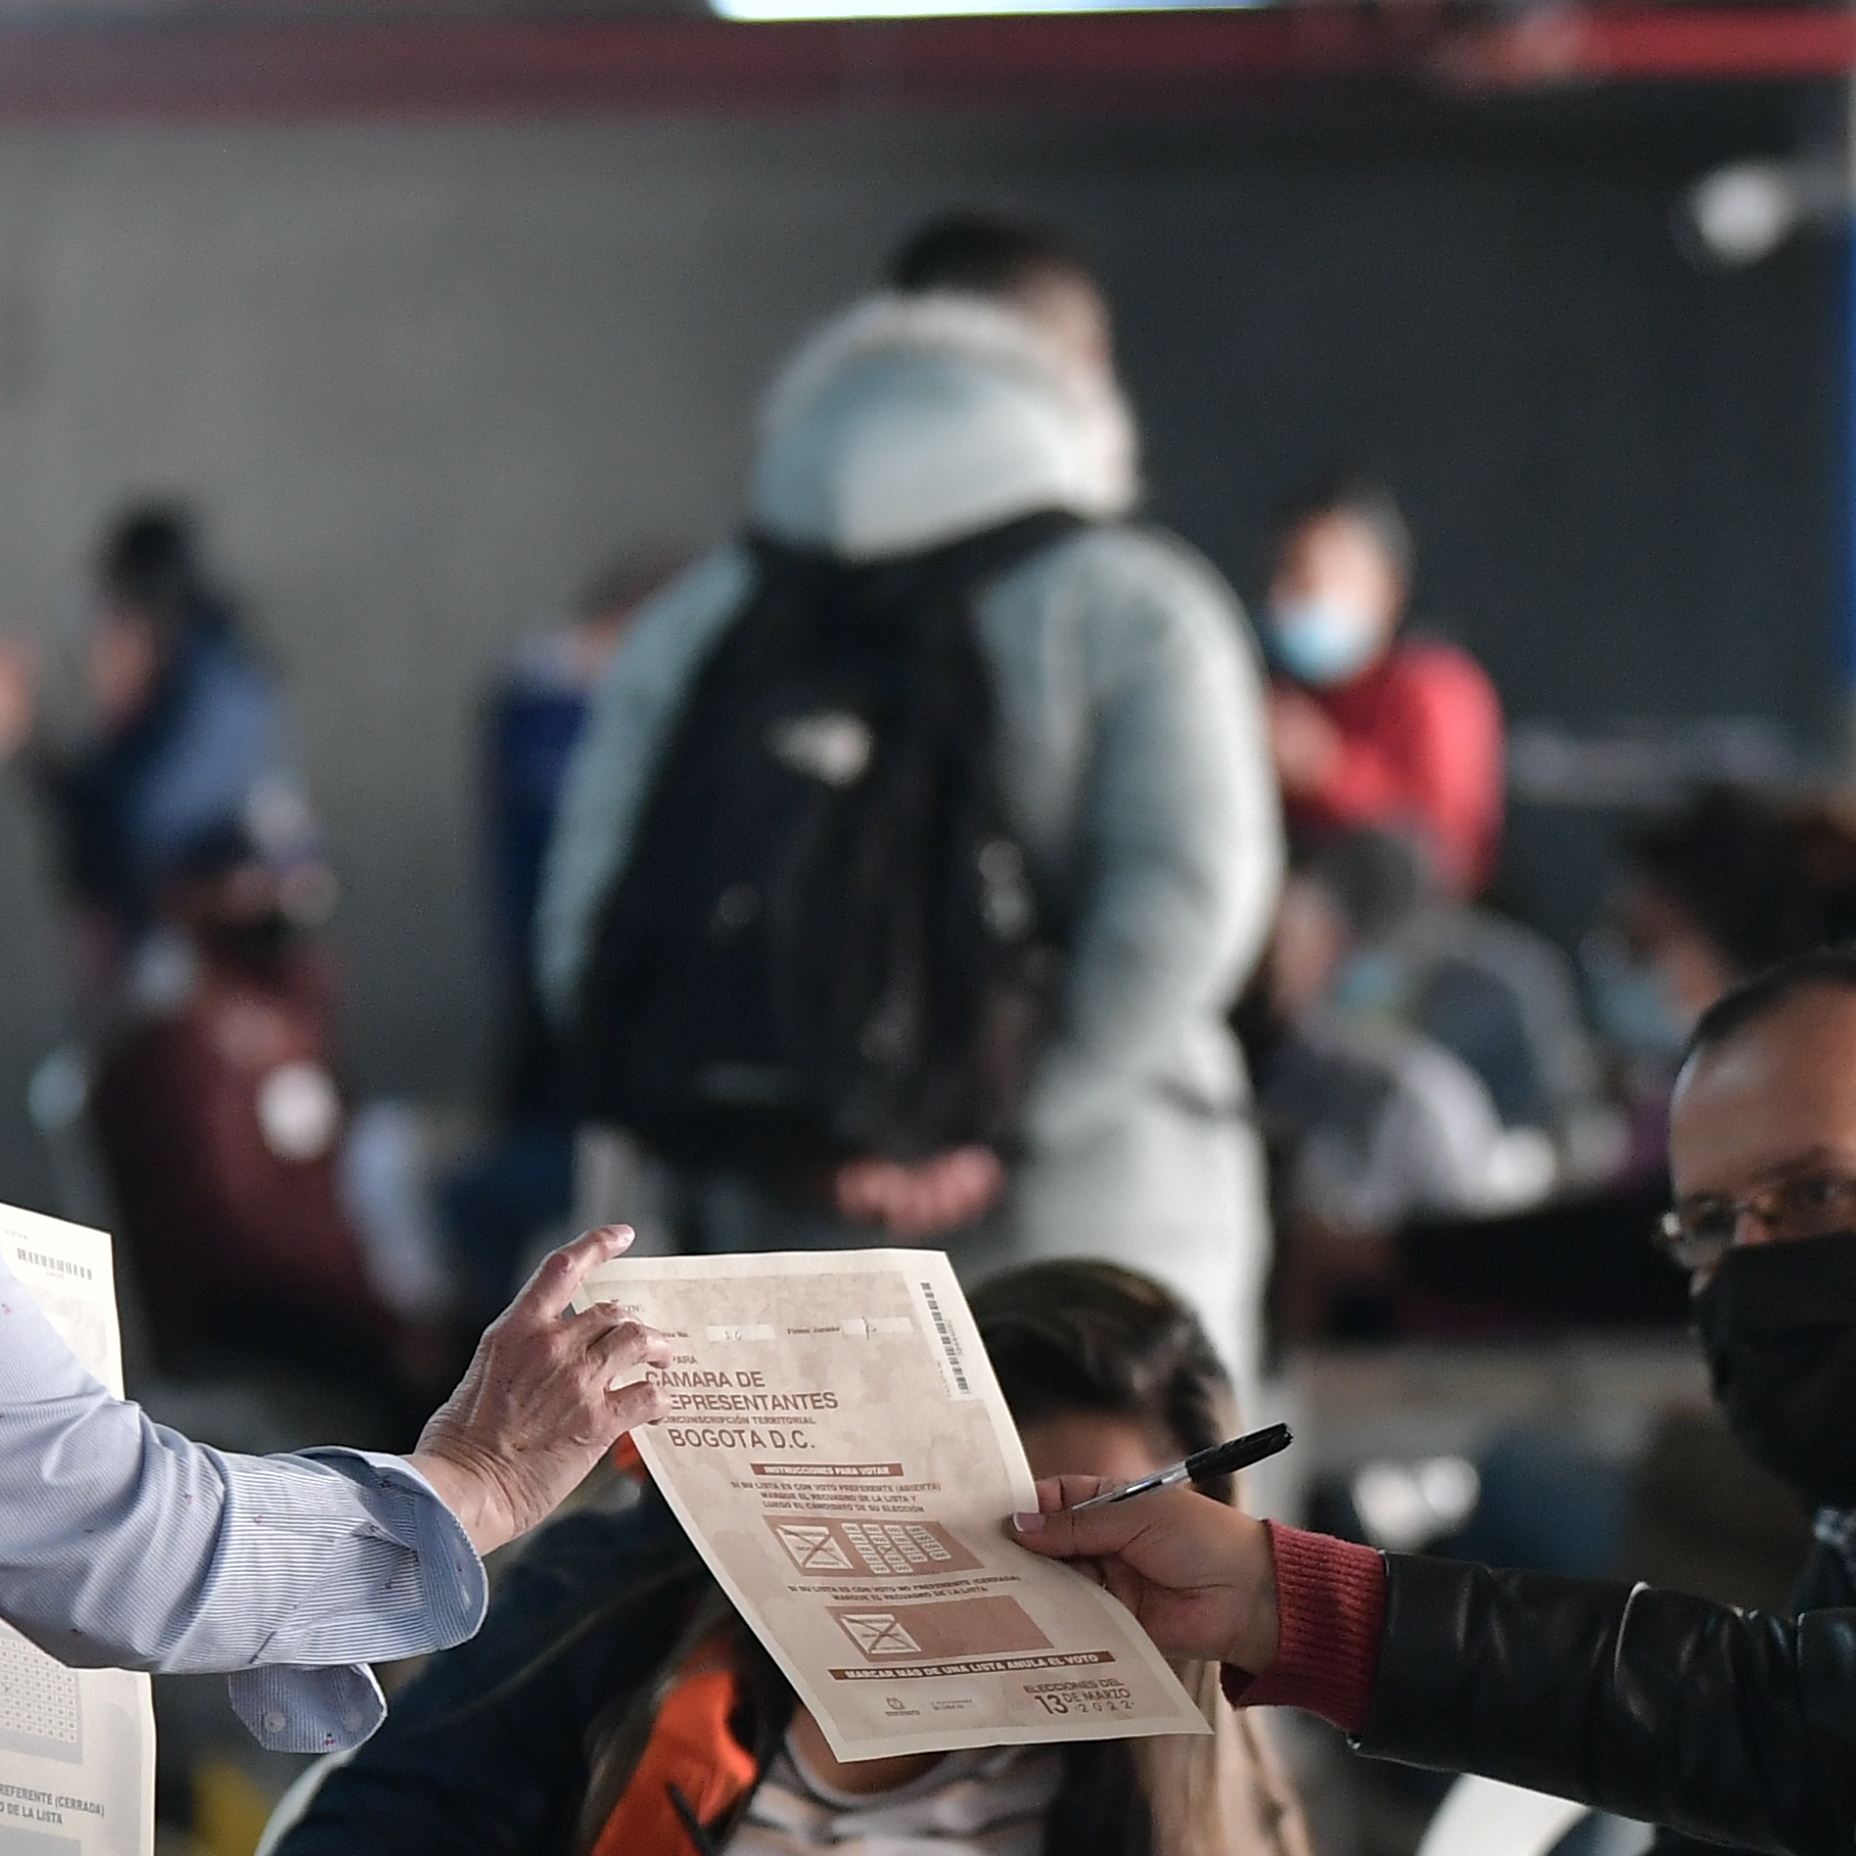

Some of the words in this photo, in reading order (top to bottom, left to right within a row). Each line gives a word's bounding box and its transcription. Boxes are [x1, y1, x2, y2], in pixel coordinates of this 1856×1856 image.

[736, 1370, 766, 1388] DE
[669, 1392, 840, 1411] EPRESENTANTES
[751, 1416, 816, 1425] TERRITORIAL
[769, 1428, 816, 1449] D.C.
[763, 1465, 834, 1475] INSTRUCCIONES
[835, 1465, 858, 1475] PARA
[858, 1465, 890, 1475] VOTAR
[844, 1668, 895, 1679] MARCAR
[923, 1666, 942, 1676] DE
[942, 1664, 969, 1675] UNA
[971, 1661, 1005, 1673] LISTA
[1007, 1658, 1048, 1669] ANULA
[1049, 1656, 1066, 1667] EL
[1067, 1654, 1099, 1665] VOTO
[1023, 1680, 1099, 1694] ELECCIONES
[1101, 1677, 1124, 1688] DEL
[1034, 1694, 1069, 1716] 13
[1063, 1692, 1083, 1704] DE
[1084, 1687, 1131, 1701] MARZO
[6, 1803, 20, 1817] DE
[22, 1805, 34, 1819] LA
[36, 1808, 63, 1825] LISTA
[55, 1796, 105, 1817] (CERRADA)
